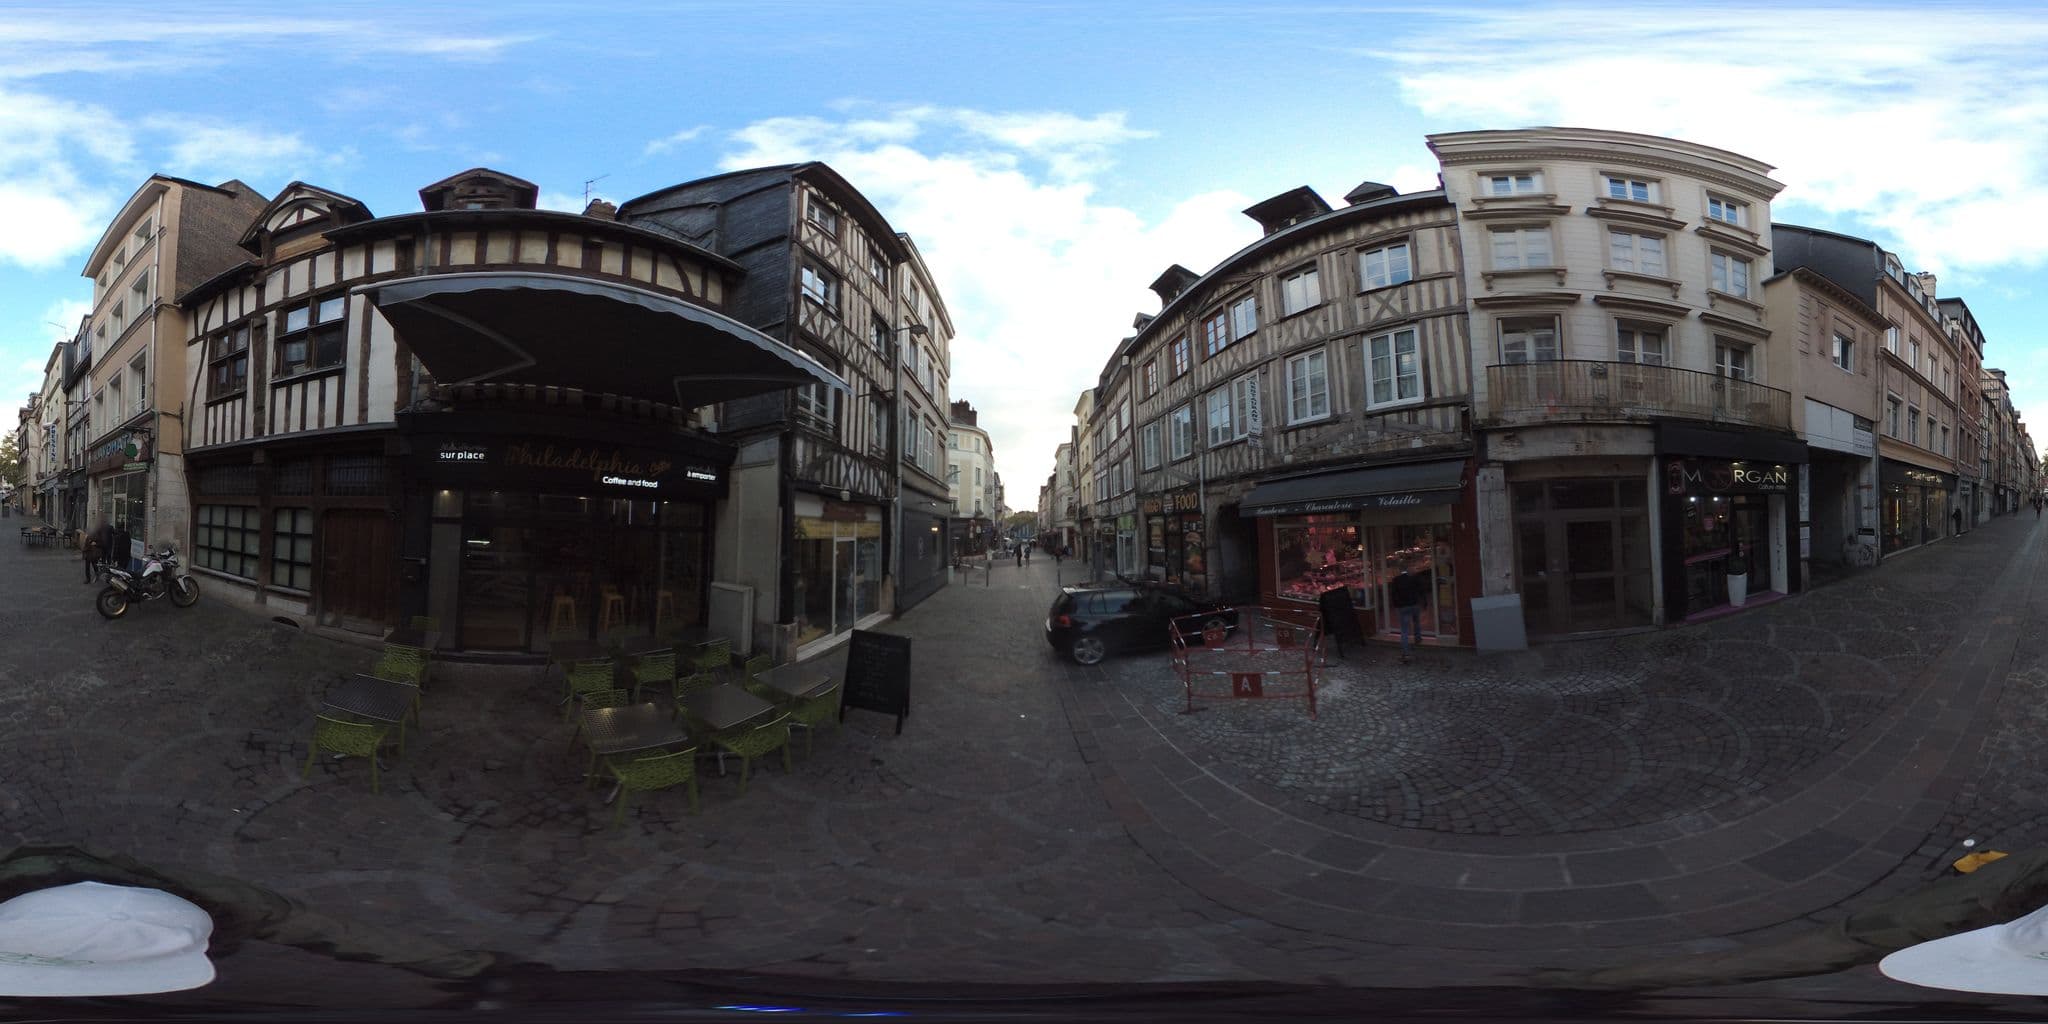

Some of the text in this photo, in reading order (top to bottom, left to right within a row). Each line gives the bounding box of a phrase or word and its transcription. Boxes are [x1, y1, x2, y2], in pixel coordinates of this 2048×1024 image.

[1250, 381, 1259, 422] RESTAURANT
[439, 450, 486, 461] sur place
[504, 442, 641, 481] Philadelphia
[602, 476, 627, 486] Coffee
[641, 480, 658, 488] food
[1175, 492, 1198, 510] FOOD
[1241, 676, 1252, 692] A
